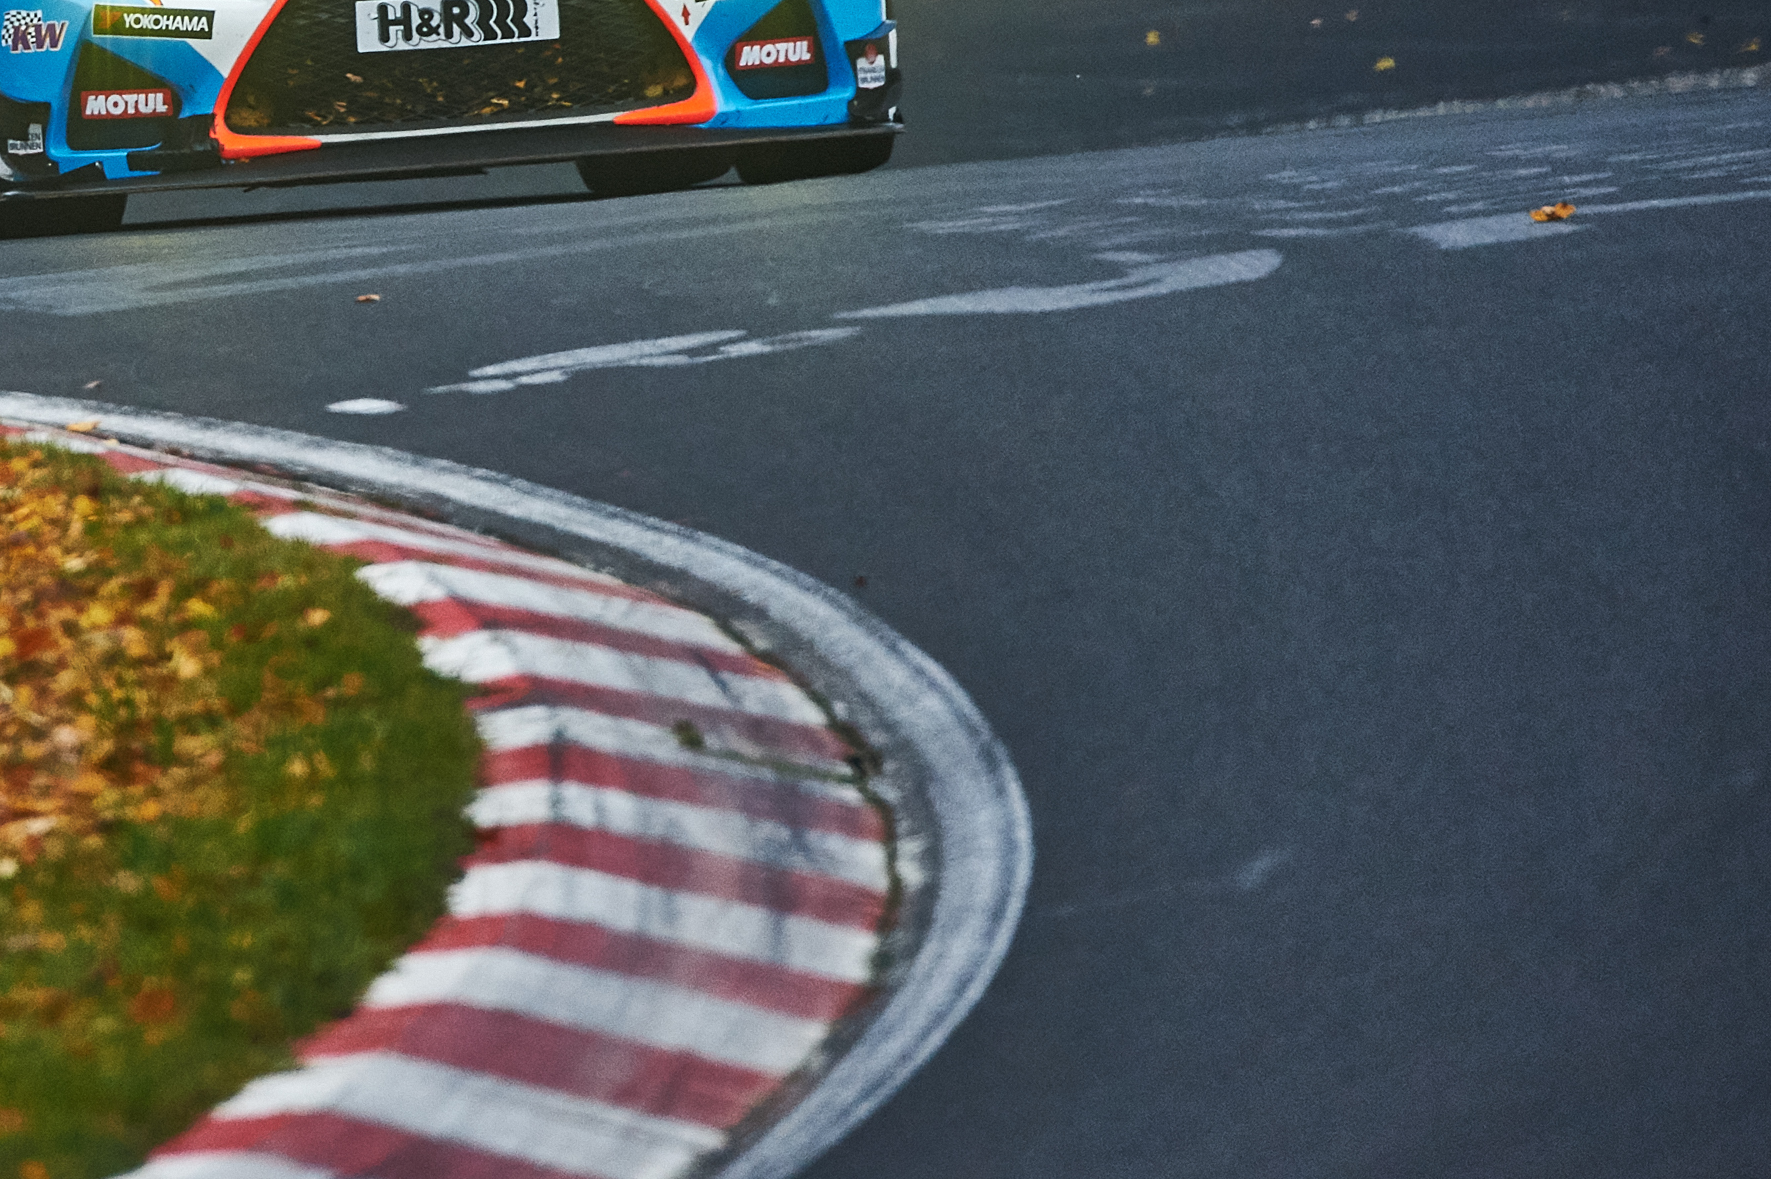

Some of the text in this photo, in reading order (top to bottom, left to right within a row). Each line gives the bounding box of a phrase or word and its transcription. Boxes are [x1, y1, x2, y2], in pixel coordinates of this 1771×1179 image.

[123, 12, 209, 32] YOKOHAMA
[10, 20, 68, 53] KW
[739, 40, 812, 66] MOTUL
[85, 92, 169, 116] MOTUL
